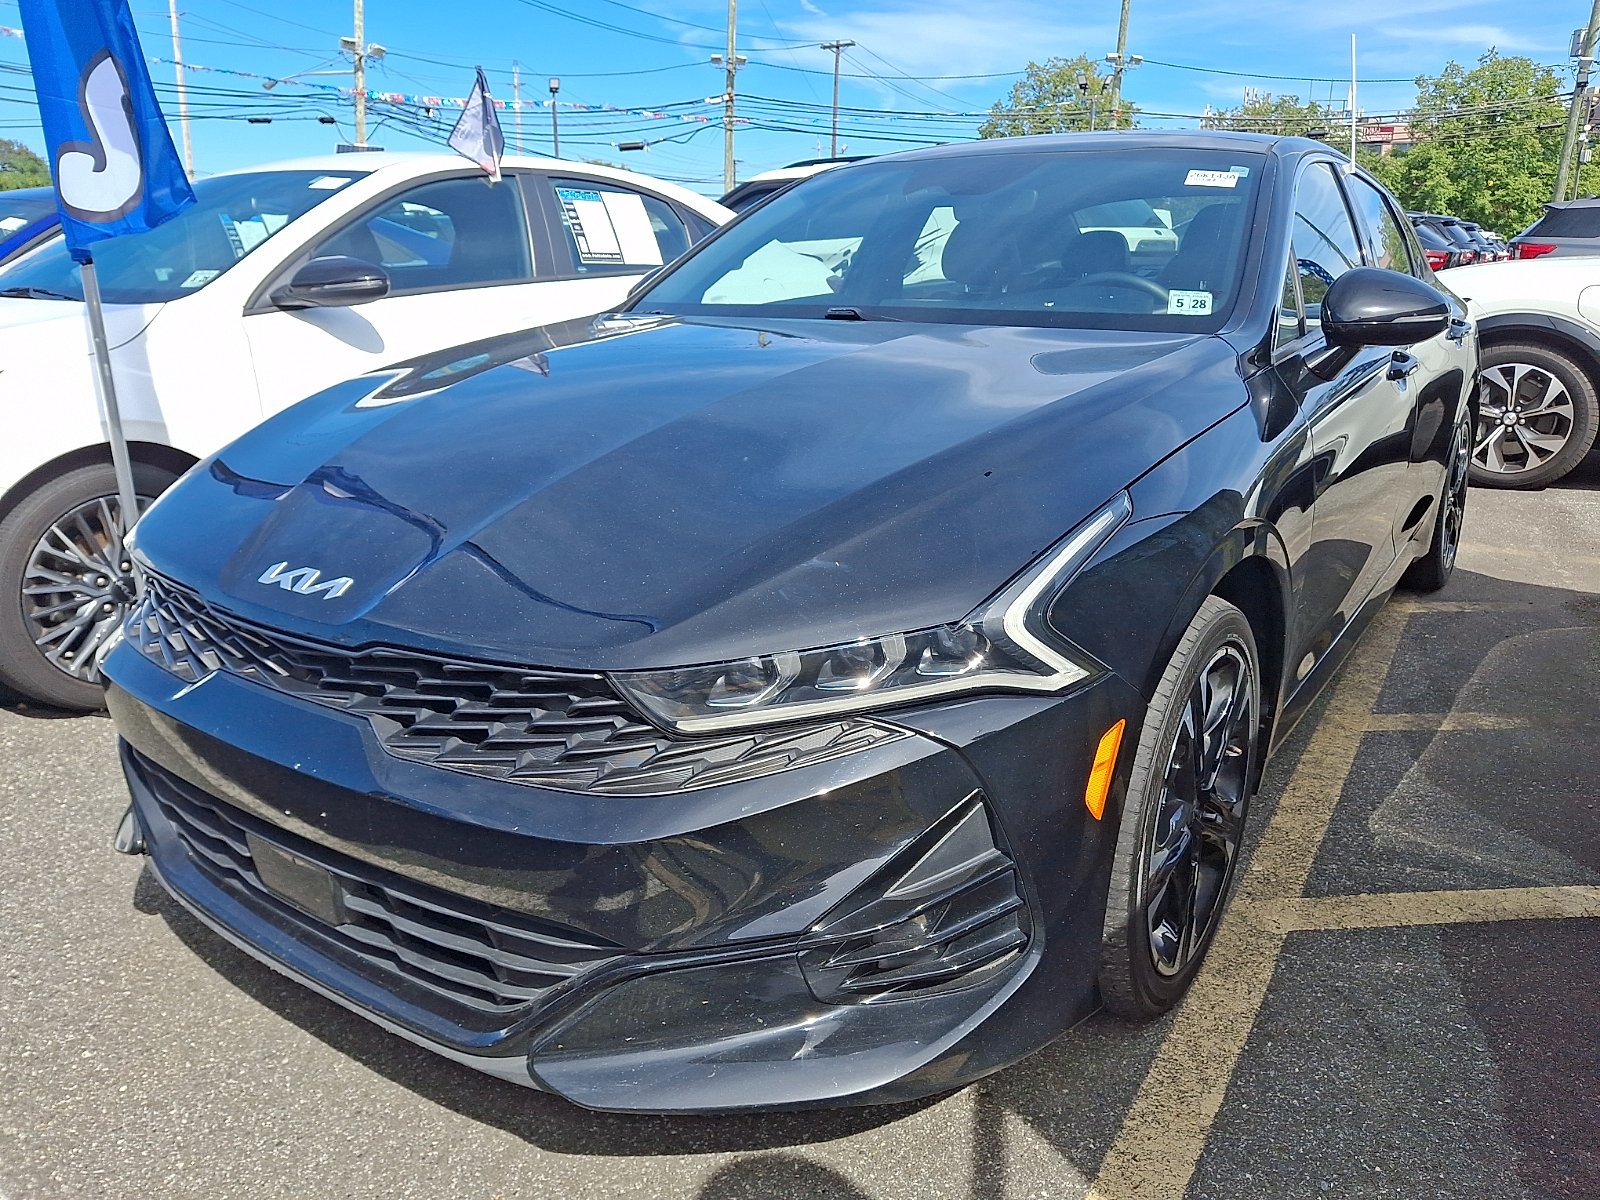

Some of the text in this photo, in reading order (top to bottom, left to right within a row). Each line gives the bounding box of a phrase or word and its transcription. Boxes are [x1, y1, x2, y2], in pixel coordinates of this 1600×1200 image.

[1176, 298, 1207, 309] 5 28
[258, 561, 354, 600] KIA
